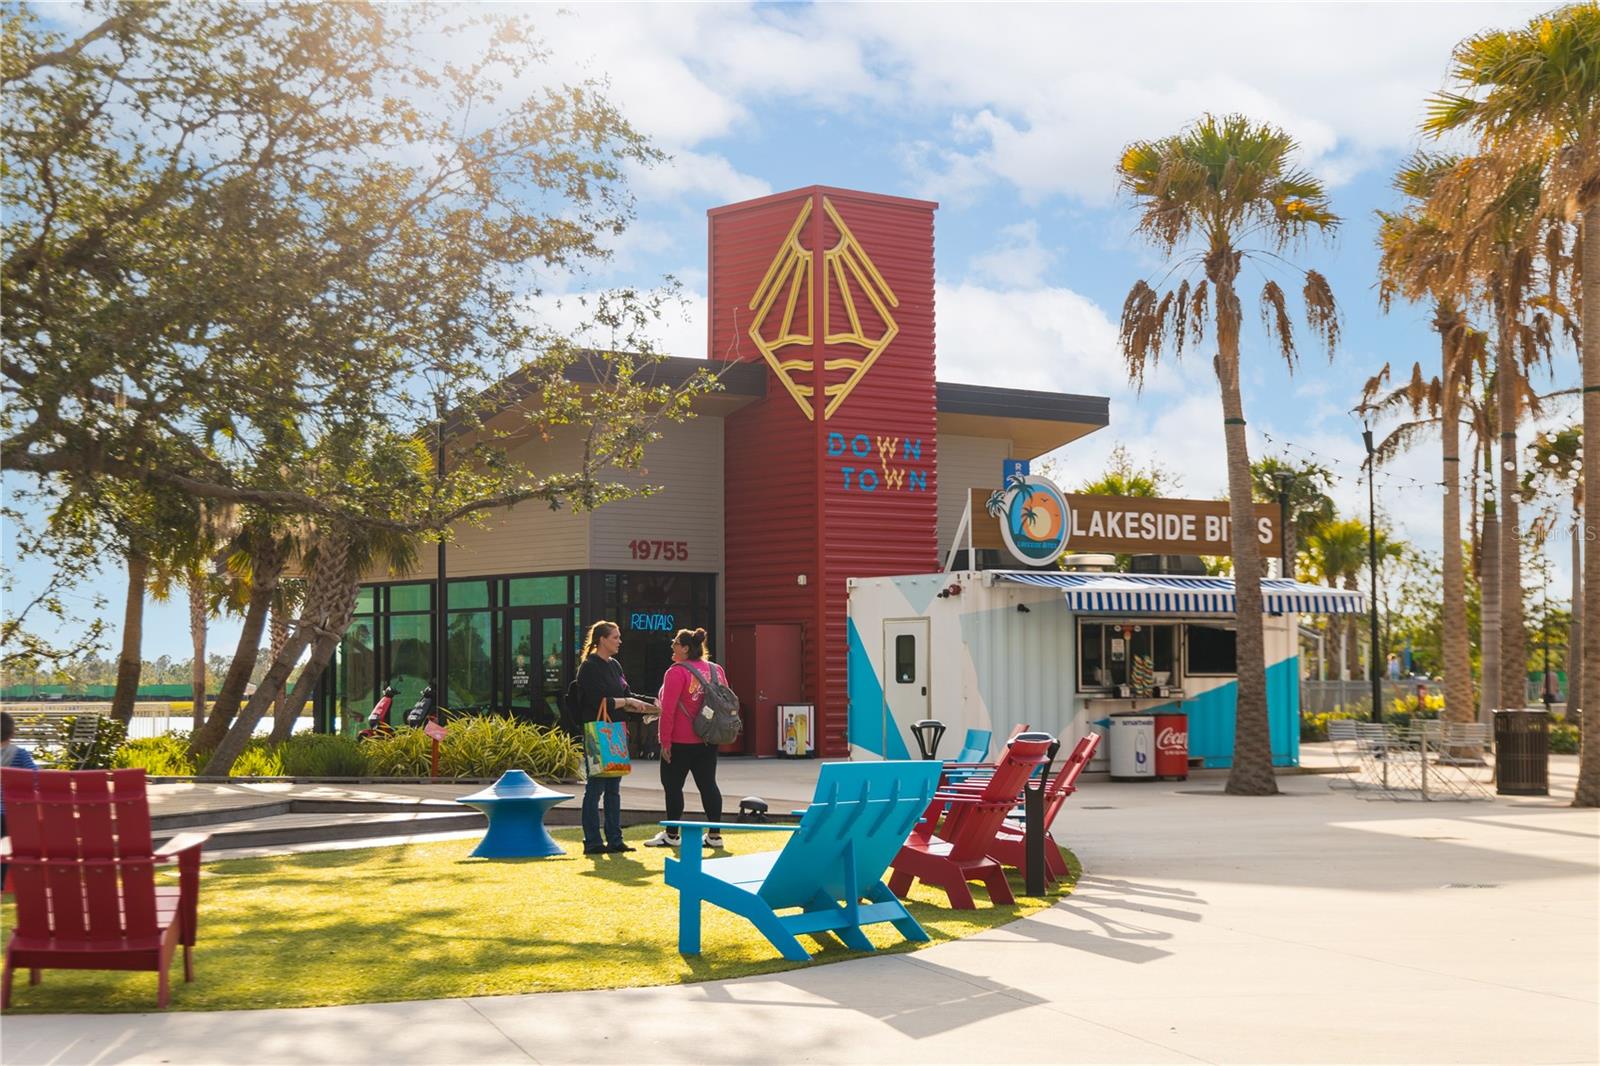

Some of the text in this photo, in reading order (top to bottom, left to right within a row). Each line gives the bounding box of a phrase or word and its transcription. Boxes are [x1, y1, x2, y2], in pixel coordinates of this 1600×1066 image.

[827, 432, 921, 460] DOWN
[841, 466, 927, 492] TOWN
[1072, 509, 1273, 544] LAKESIDE BIS
[628, 540, 689, 560] 19755
[631, 613, 674, 631] RENTALS
